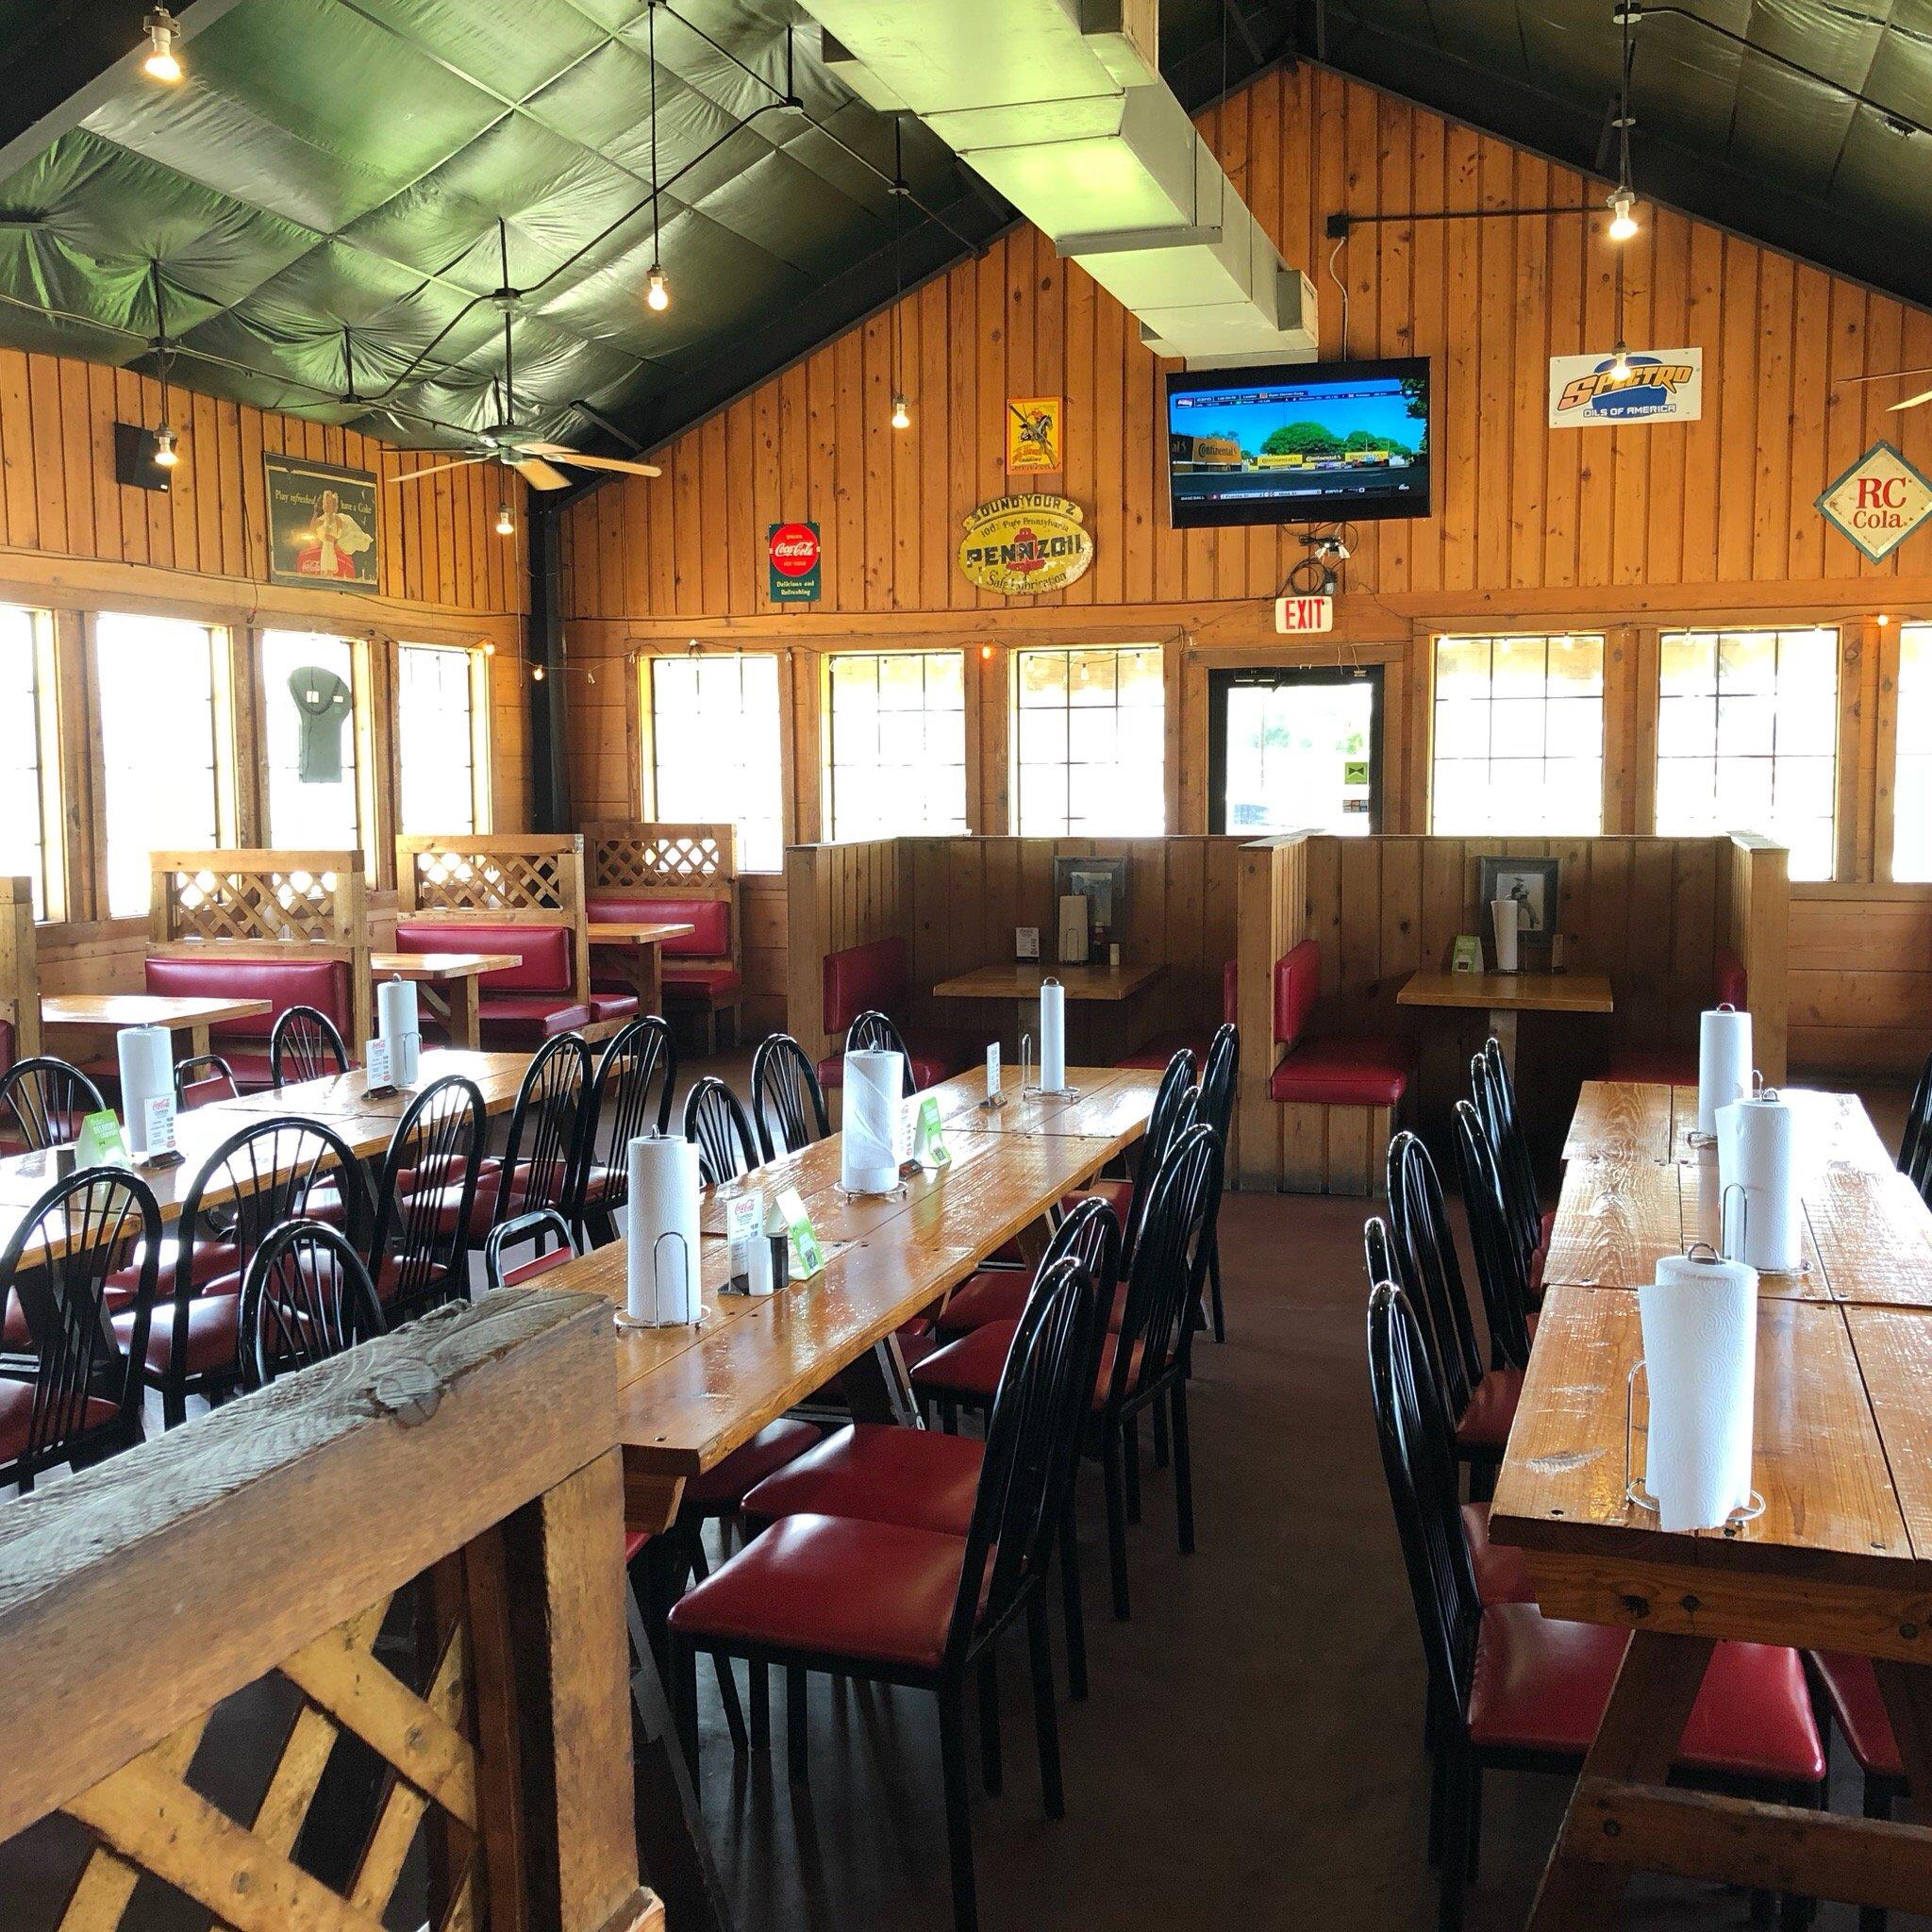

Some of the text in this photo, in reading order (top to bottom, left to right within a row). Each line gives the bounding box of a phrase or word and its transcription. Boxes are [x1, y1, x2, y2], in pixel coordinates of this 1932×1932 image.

[1584, 404, 1675, 418] OILS OF AMERICA
[275, 489, 289, 503] Play
[1856, 477, 1907, 509] RC
[341, 500, 353, 511] have
[358, 504, 372, 514] Coke
[970, 497, 1022, 522] SOUND
[1023, 495, 1060, 510] YOUR
[1023, 517, 1070, 532] Pennsylvania
[1853, 510, 1904, 529] Cola
[774, 541, 814, 558] Coca-Cola
[966, 534, 1081, 569] PENNZOIL
[781, 589, 811, 597] Refreshing
[1285, 598, 1324, 630] EXIT
